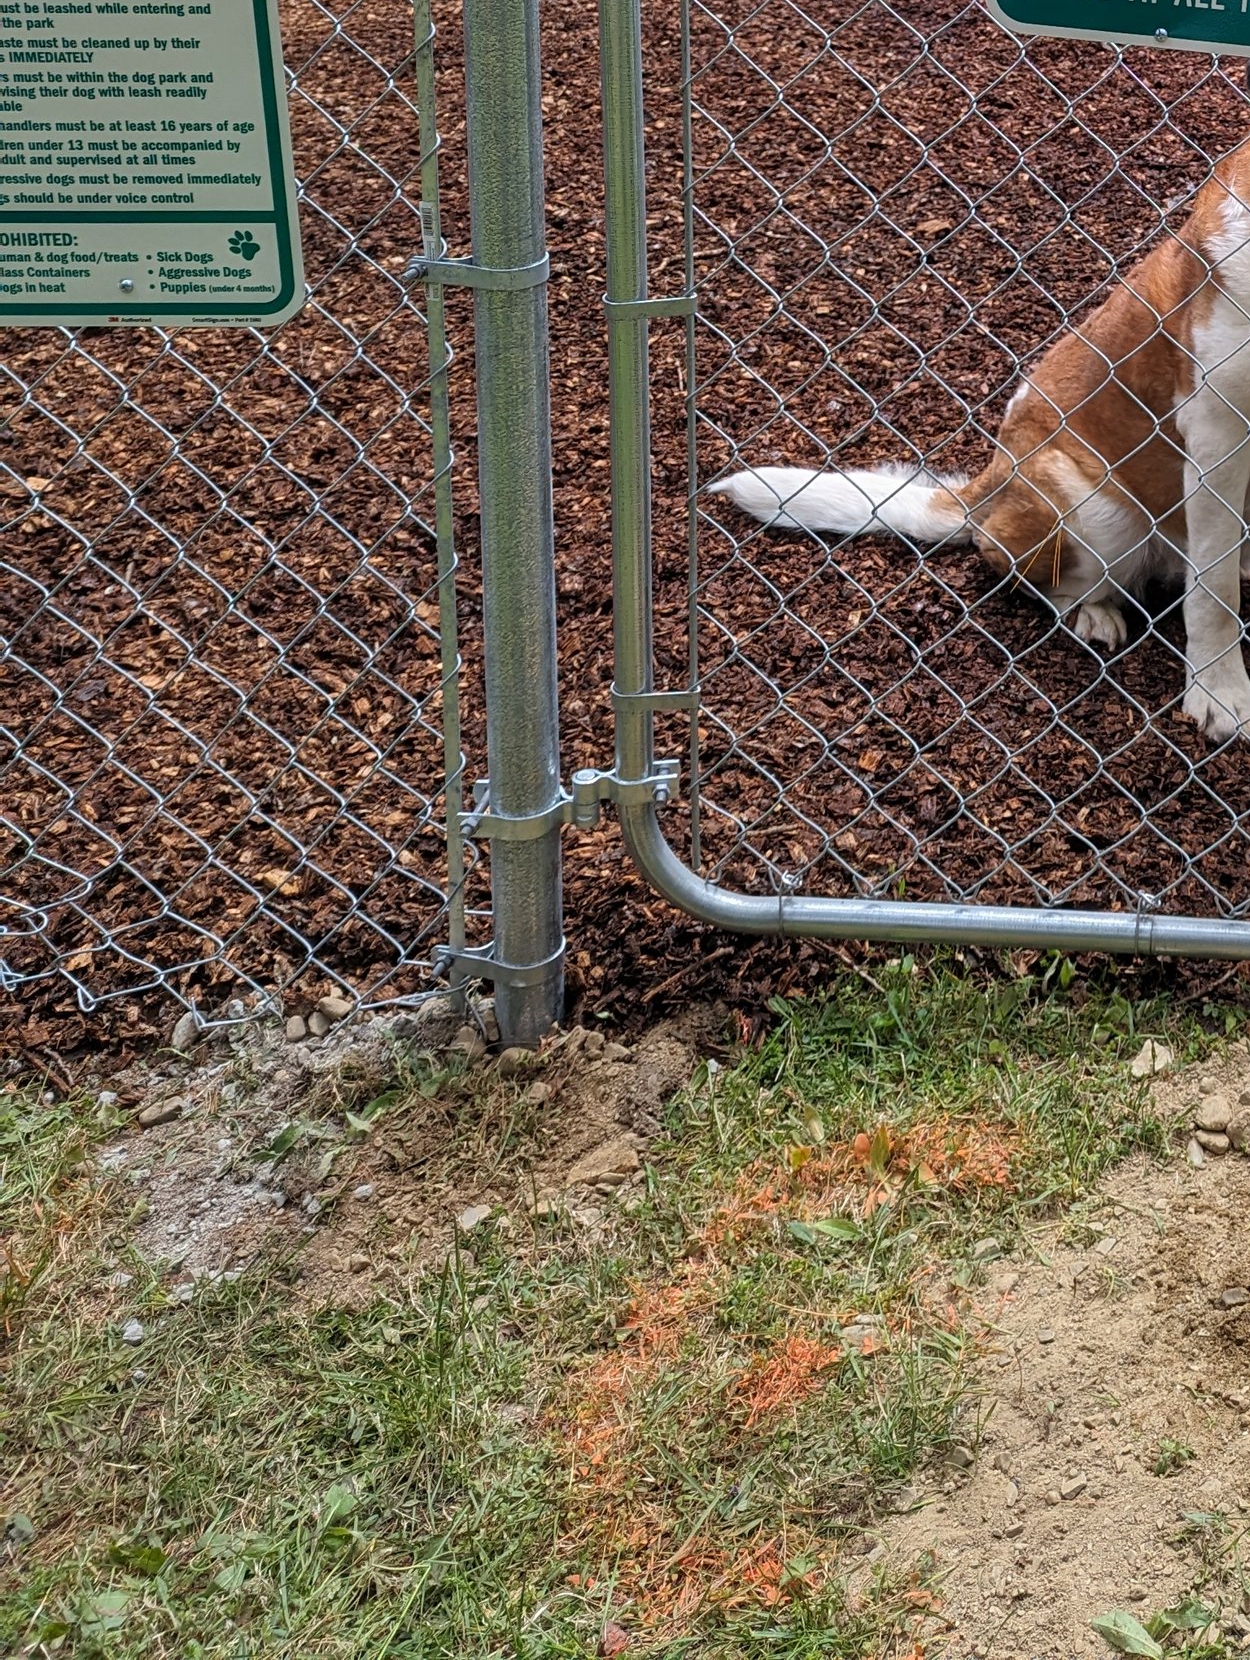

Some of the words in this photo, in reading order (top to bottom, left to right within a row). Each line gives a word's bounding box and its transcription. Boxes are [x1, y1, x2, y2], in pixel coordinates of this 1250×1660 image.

[0, 3, 21, 13] ust
[24, 3, 39, 13] be
[43, 3, 92, 13] leashed
[95, 3, 128, 13] while
[133, 3, 185, 16] entering
[188, 3, 211, 14] and
[2, 17, 22, 28] the
[26, 17, 54, 30] park
[27, 38, 58, 48] must
[62, 37, 77, 48] be
[81, 37, 130, 48] cleaned
[134, 40, 149, 51] up
[154, 38, 167, 51] by
[171, 38, 200, 48] their
[9, 52, 94, 63] IMMEDIATELY
[13, 72, 44, 82] must
[47, 72, 62, 82] be
[66, 72, 104, 82] within
[108, 72, 128, 82] the
[132, 72, 155, 87] dog
[159, 72, 187, 85] park
[191, 72, 213, 83] and
[39, 86, 68, 97] their
[72, 86, 95, 99] dog
[98, 86, 124, 97] with
[128, 86, 161, 97] leash
[166, 86, 207, 100] readily
[55, 121, 86, 131] must
[90, 120, 105, 131] be
[109, 121, 122, 131] at
[125, 120, 156, 131] least
[161, 120, 176, 131] 16
[179, 123, 212, 133] years
[217, 120, 228, 131] of
[233, 122, 254, 134] age
[28, 140, 63, 150] under
[68, 140, 83, 150] 13
[88, 140, 119, 150] must
[122, 140, 137, 150] be
[142, 140, 223, 153] accompanied
[227, 140, 240, 153] by
[0, 154, 26, 164] dult
[30, 154, 52, 165] and
[56, 154, 122, 167] supervised
[126, 155, 139, 165] at
[143, 154, 157, 165] all
[161, 154, 196, 165] times
[46, 173, 75, 186] dogs
[79, 174, 110, 184] must
[113, 174, 128, 184] be
[132, 173, 183, 184] removed
[187, 173, 261, 186] immediately
[14, 193, 54, 203] should
[58, 193, 73, 203] be
[77, 193, 112, 203] under
[115, 193, 147, 203] voice
[151, 192, 194, 203] control
[34, 252, 44, 262] &
[47, 252, 68, 264] dog
[70, 252, 139, 264] food/treats
[157, 252, 182, 262] Sick
[185, 252, 214, 264] Dogs
[27, 267, 90, 277] Containers
[159, 267, 220, 279] Aggressive
[223, 267, 252, 279] Dogs
[25, 282, 36, 292] in
[39, 282, 65, 292] heat
[160, 282, 206, 294] Puppies
[209, 285, 235, 293] (under
[243, 285, 275, 293] months)
